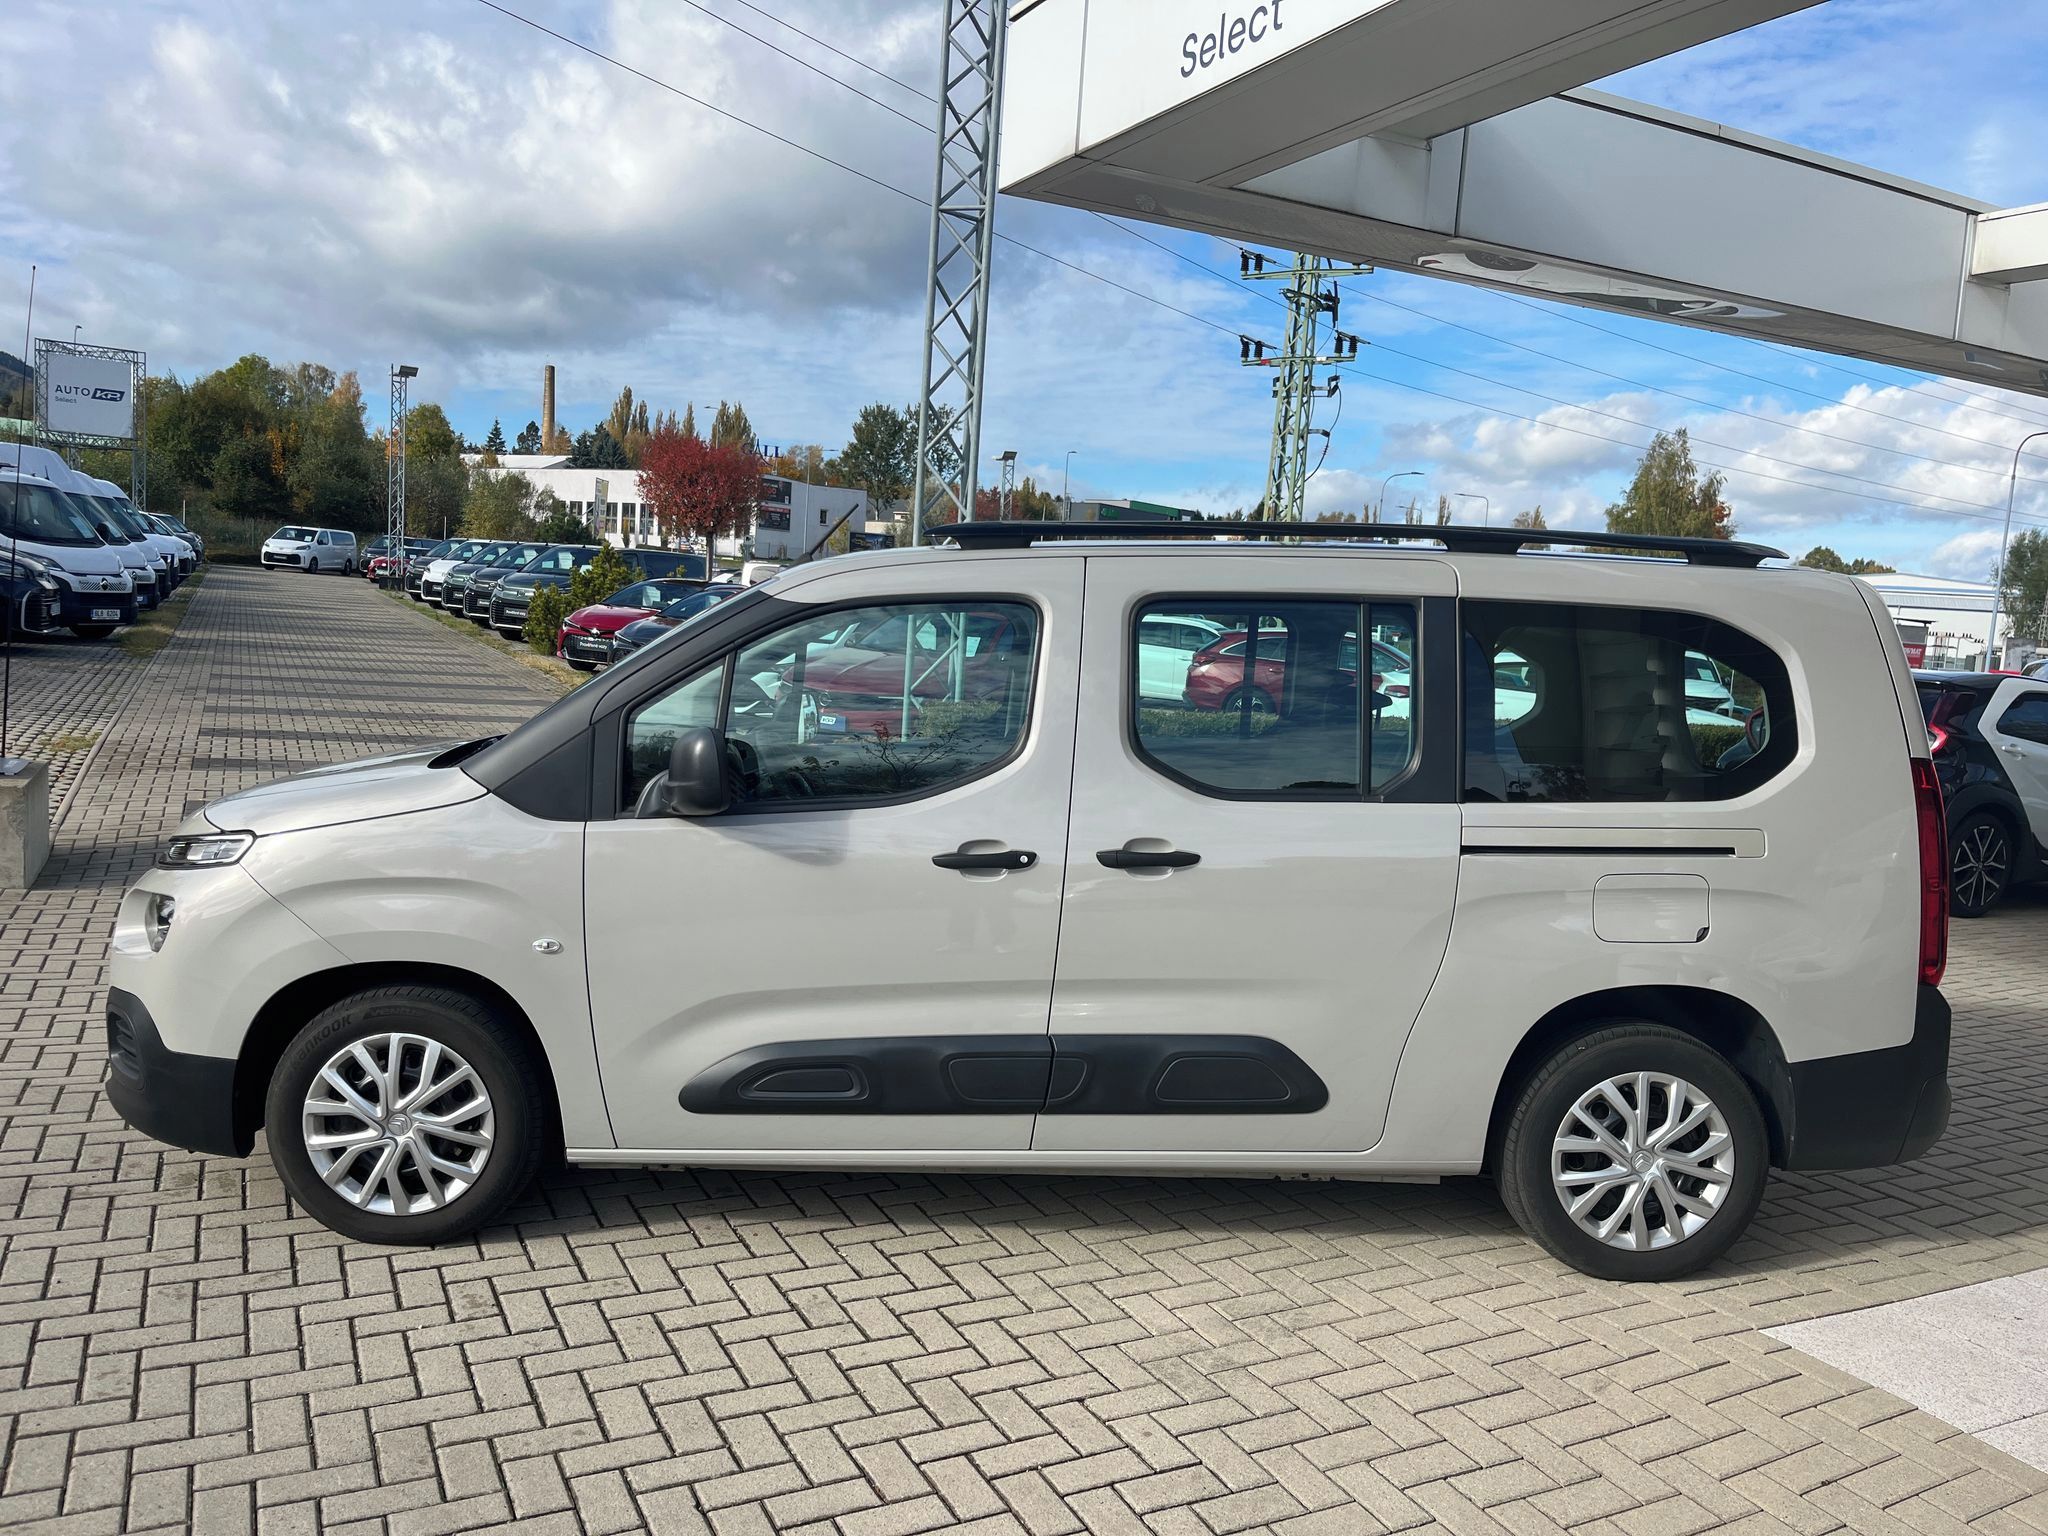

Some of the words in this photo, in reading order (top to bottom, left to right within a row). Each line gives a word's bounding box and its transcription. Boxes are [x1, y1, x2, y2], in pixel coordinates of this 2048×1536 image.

[1180, 0, 1284, 78] Select
[55, 384, 90, 397] AUTO
[55, 396, 77, 404] Select
